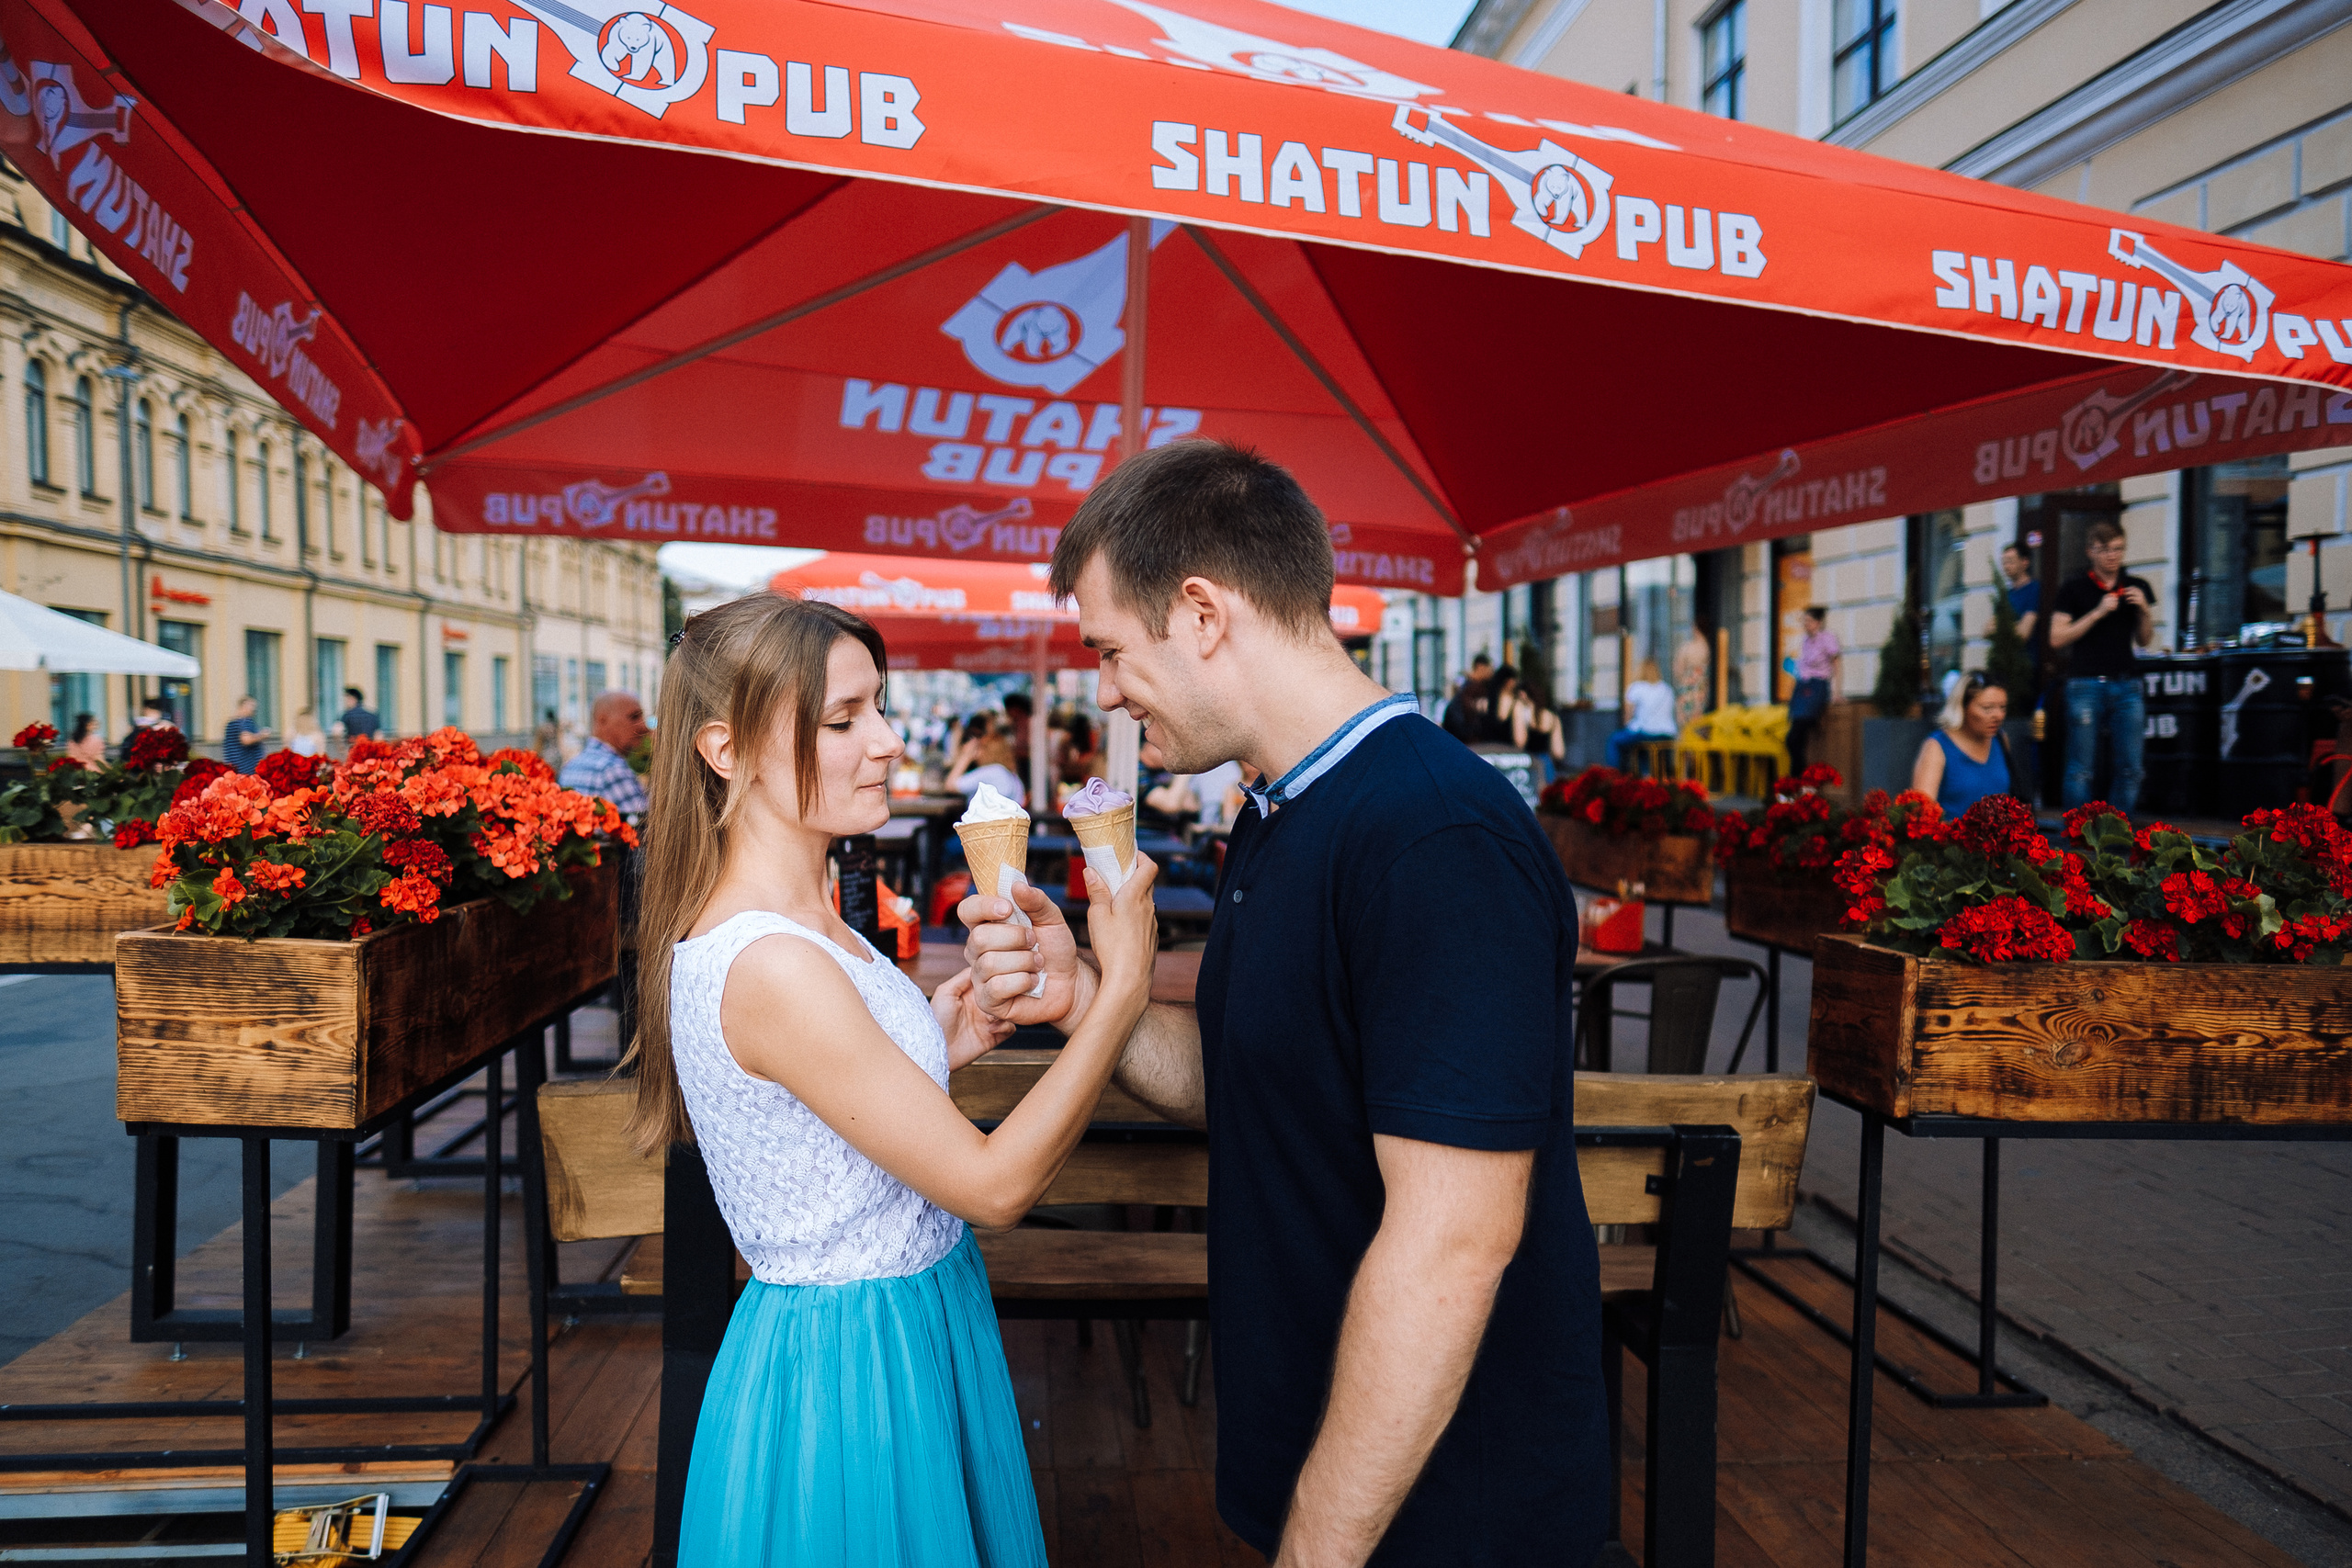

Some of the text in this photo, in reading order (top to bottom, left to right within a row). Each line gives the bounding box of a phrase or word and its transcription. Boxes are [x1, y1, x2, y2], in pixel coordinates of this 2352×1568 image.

[235, 0, 927, 150] ATUN PUB
[1150, 120, 1490, 238] SHATUN
[1614, 195, 1769, 279] PUB
[1932, 250, 2352, 366] SHATUN PU
[2143, 671, 2207, 696] TUN
